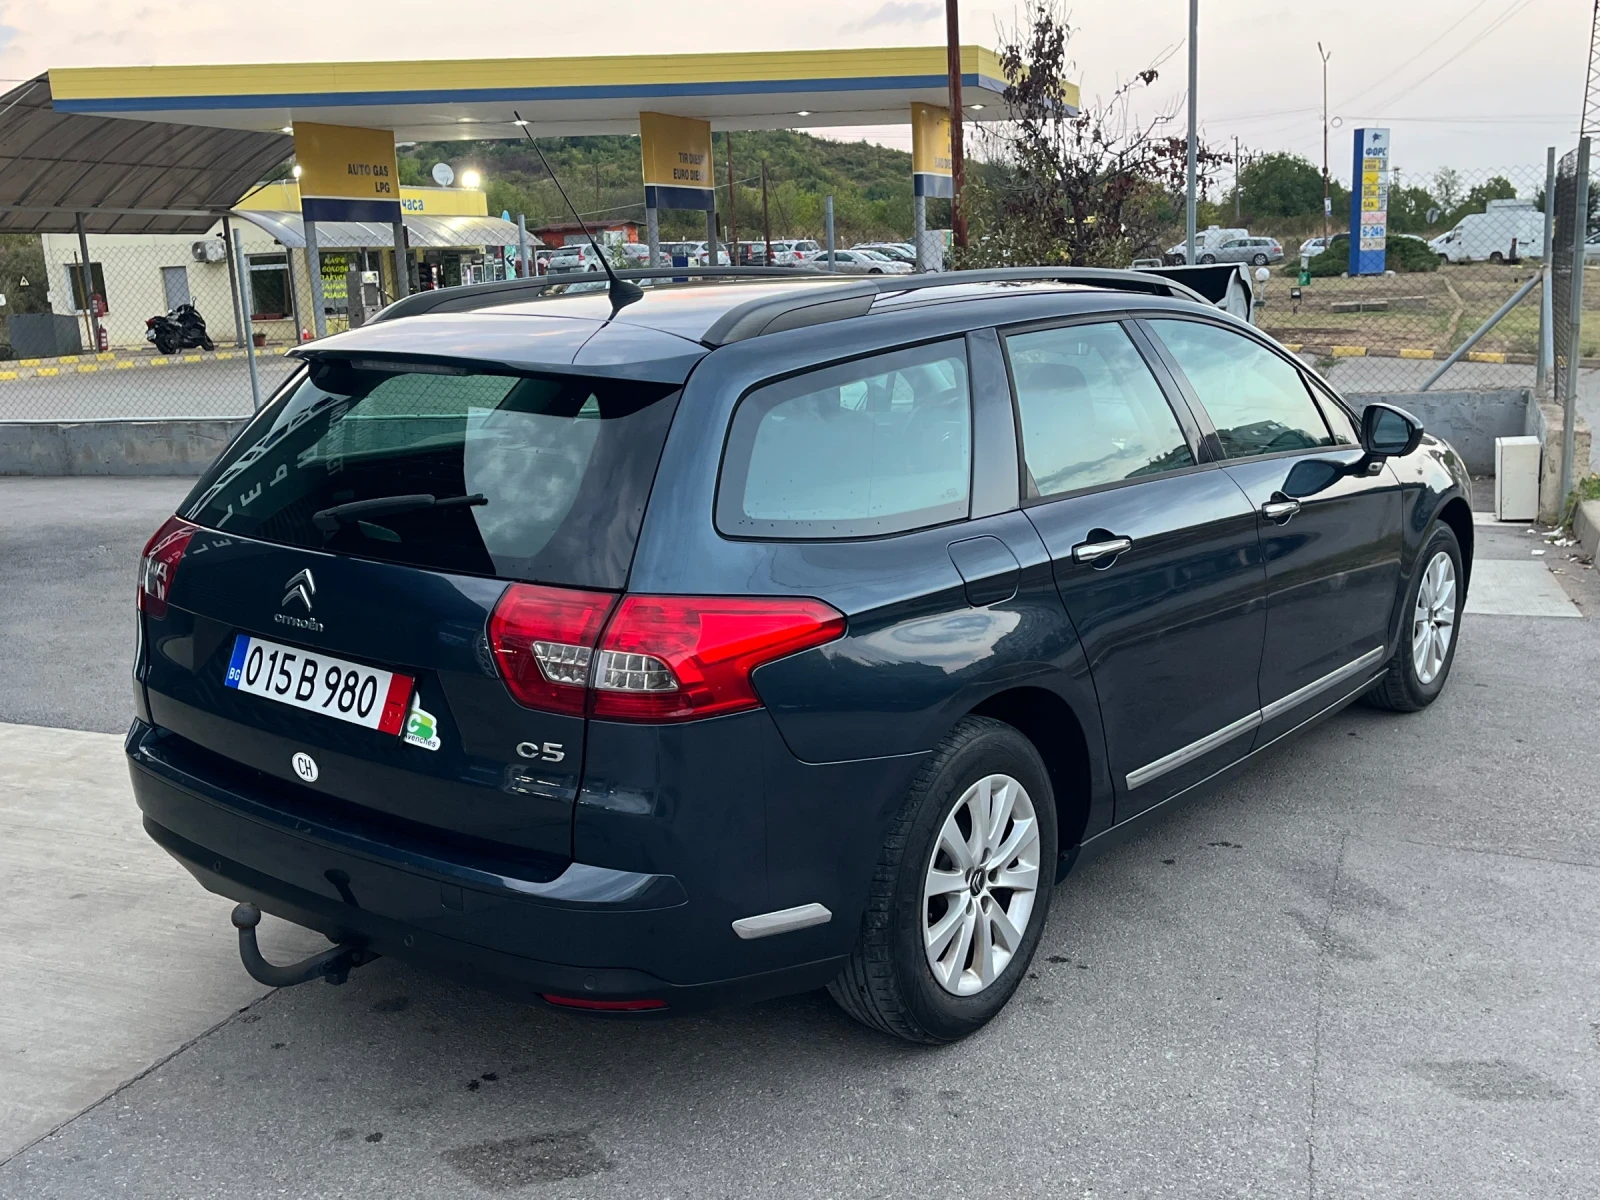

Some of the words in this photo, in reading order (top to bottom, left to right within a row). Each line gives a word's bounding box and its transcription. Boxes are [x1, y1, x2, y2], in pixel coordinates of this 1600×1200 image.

[1365, 147, 1387, 156] ФОРС
[348, 163, 371, 176] AUTO
[373, 165, 389, 177] GAS
[673, 168, 689, 181] EURO
[375, 182, 390, 193] LPG
[229, 667, 241, 681] BG
[516, 741, 565, 762] C5
[297, 757, 313, 777] CH
